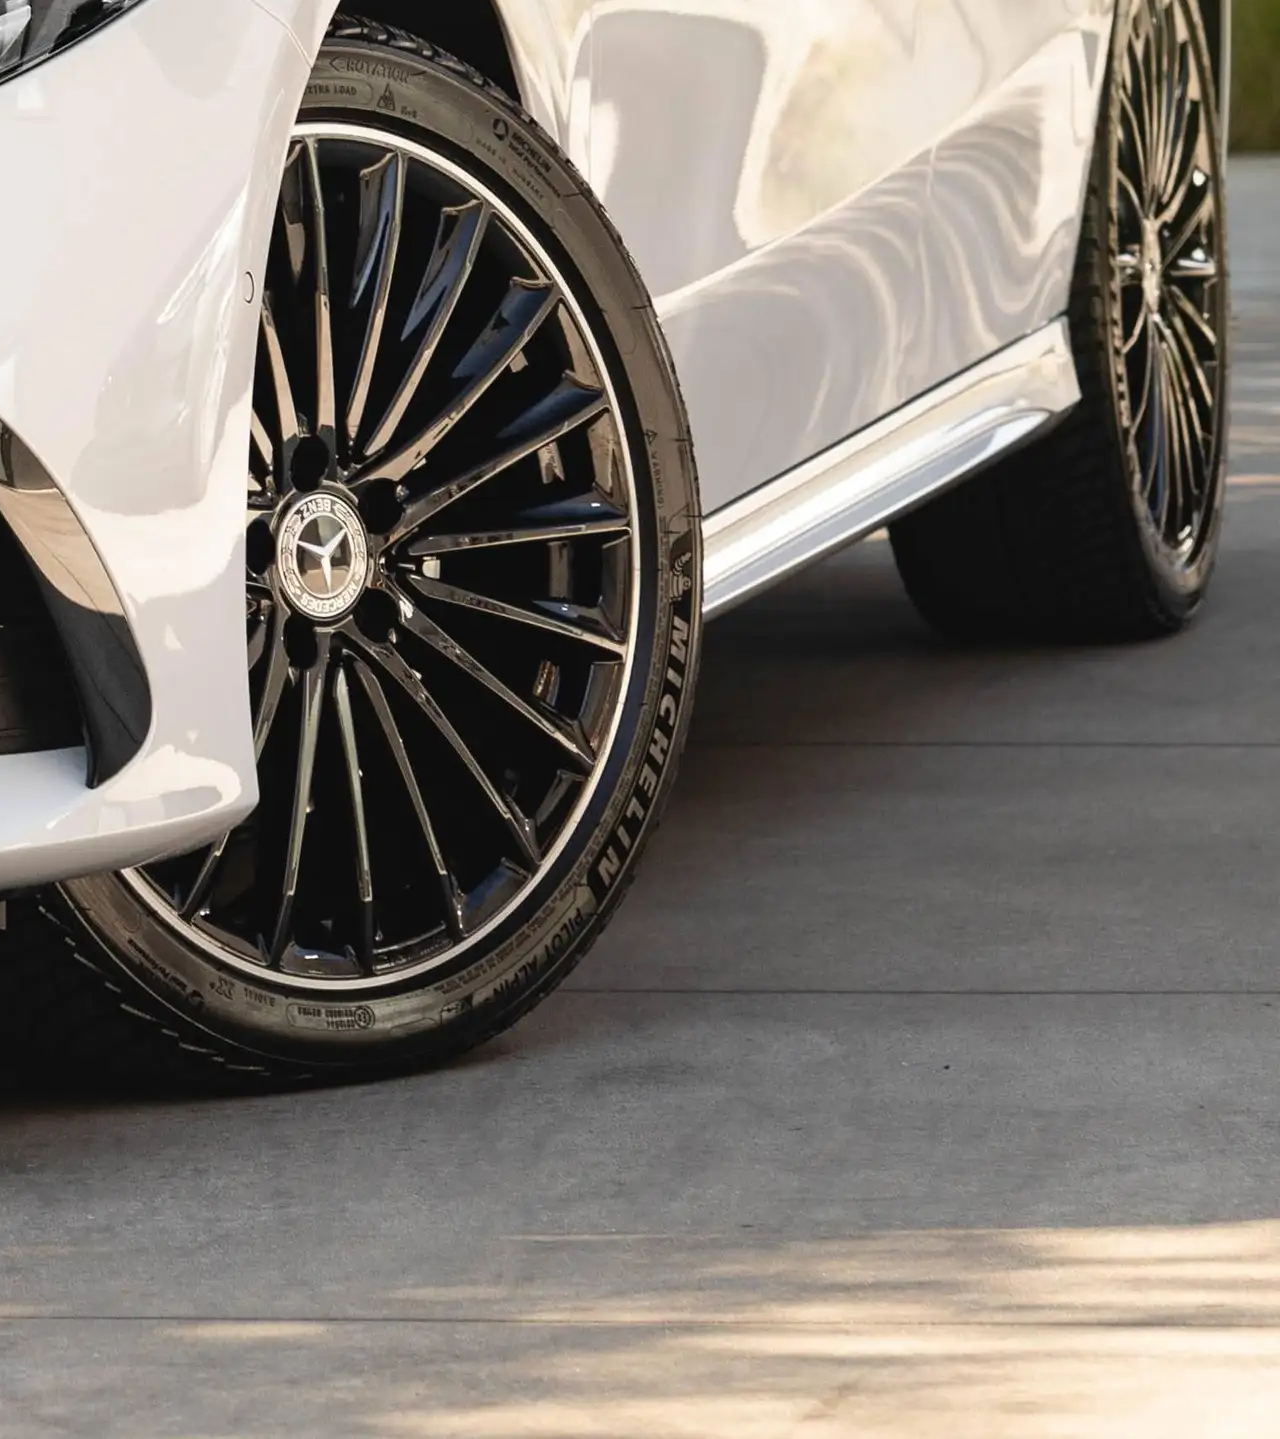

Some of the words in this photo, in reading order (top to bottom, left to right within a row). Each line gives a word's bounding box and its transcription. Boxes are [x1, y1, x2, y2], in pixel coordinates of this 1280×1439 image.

[346, 58, 410, 83] ROTATION
[333, 85, 358, 97] LOAD
[511, 131, 552, 174] MICHELIN
[300, 498, 333, 519] BENZ
[299, 580, 358, 613] MERCEDES
[596, 614, 690, 887] MICHELIN
[544, 907, 585, 961] PILOT
[491, 955, 539, 996] ALPIN
